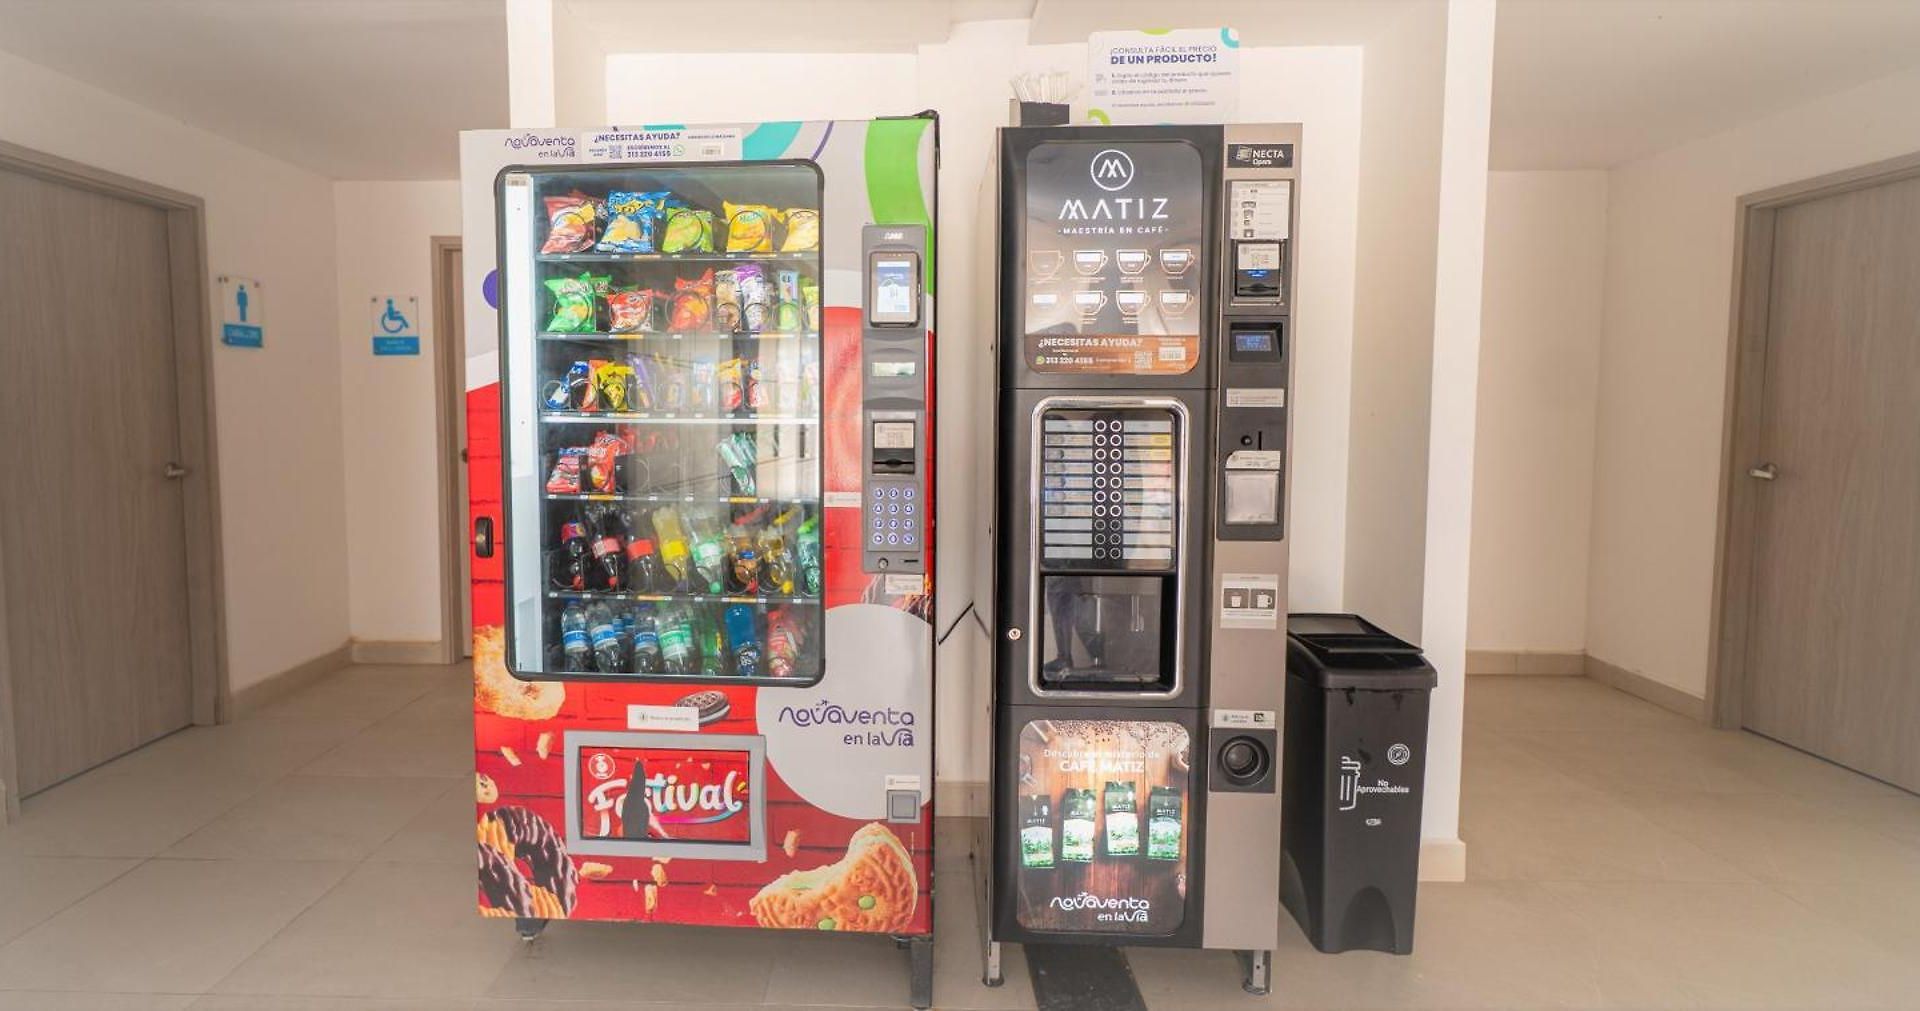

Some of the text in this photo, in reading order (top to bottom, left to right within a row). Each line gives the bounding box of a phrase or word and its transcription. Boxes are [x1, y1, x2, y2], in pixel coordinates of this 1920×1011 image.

[1110, 53, 1217, 65] DE UN PRODUCTO!
[645, 132, 681, 142] AYUDA?
[1252, 149, 1285, 159] NECTA
[1058, 198, 1169, 220] MATIZ
[1119, 226, 1133, 234] EN
[1038, 338, 1098, 348] ¿NECESITAS
[843, 733, 863, 745] en
[1377, 779, 1389, 787] No
[588, 770, 743, 838] Ftival
[1097, 913, 1113, 921] en
